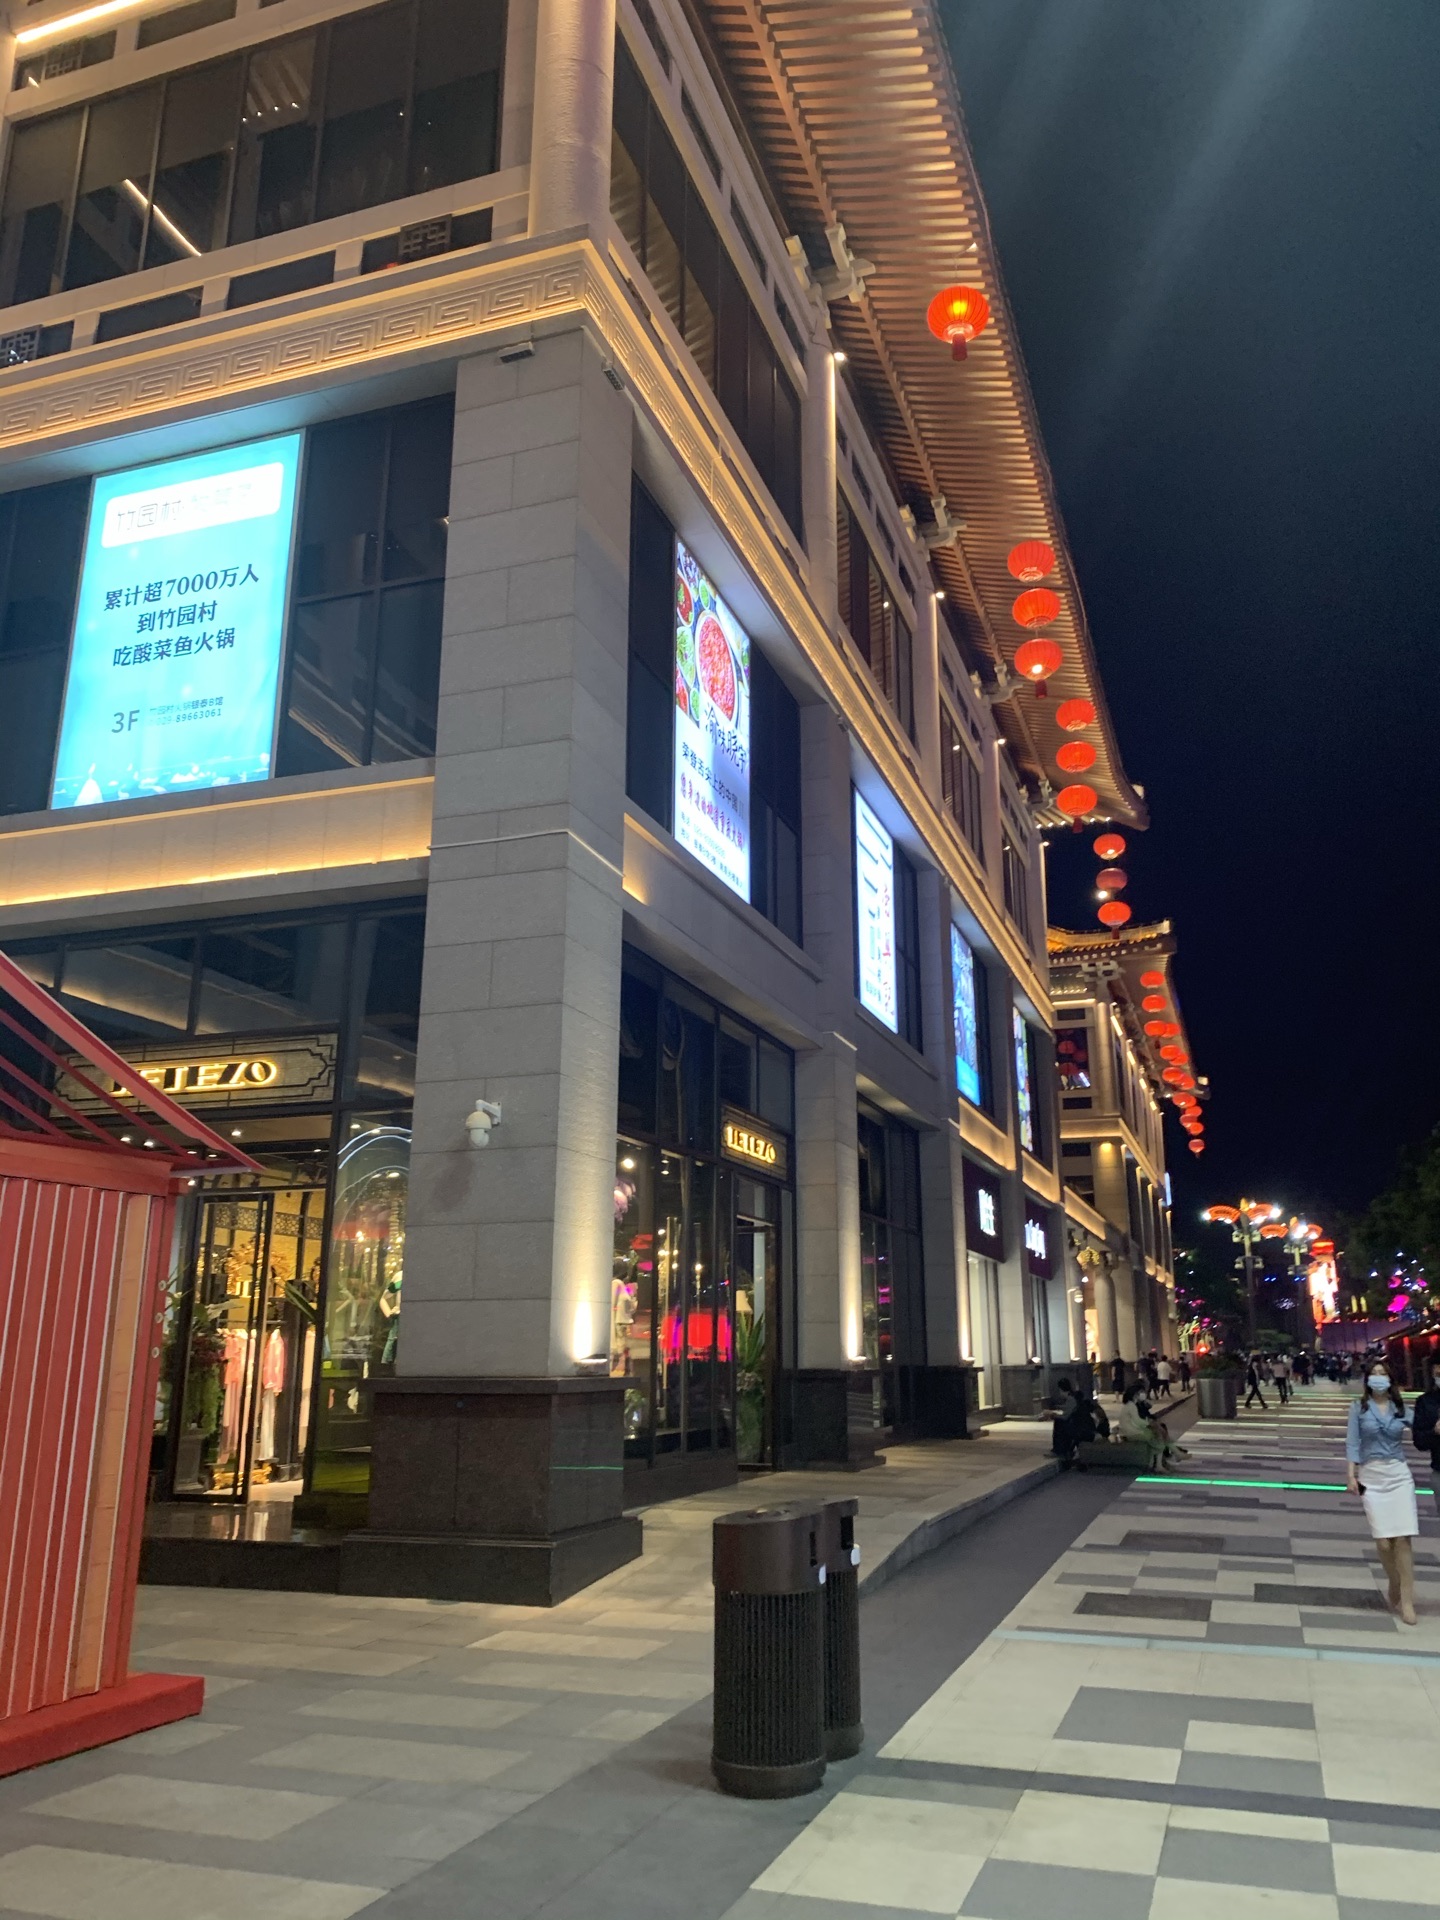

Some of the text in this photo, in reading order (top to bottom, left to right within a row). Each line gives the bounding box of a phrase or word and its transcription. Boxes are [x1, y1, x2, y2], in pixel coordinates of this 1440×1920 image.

[103, 563, 259, 611] 累计超7000万人
[137, 600, 218, 634] 到竹园村
[112, 627, 235, 667] 吃酸菜鱼火锅
[111, 709, 140, 734] 3F
